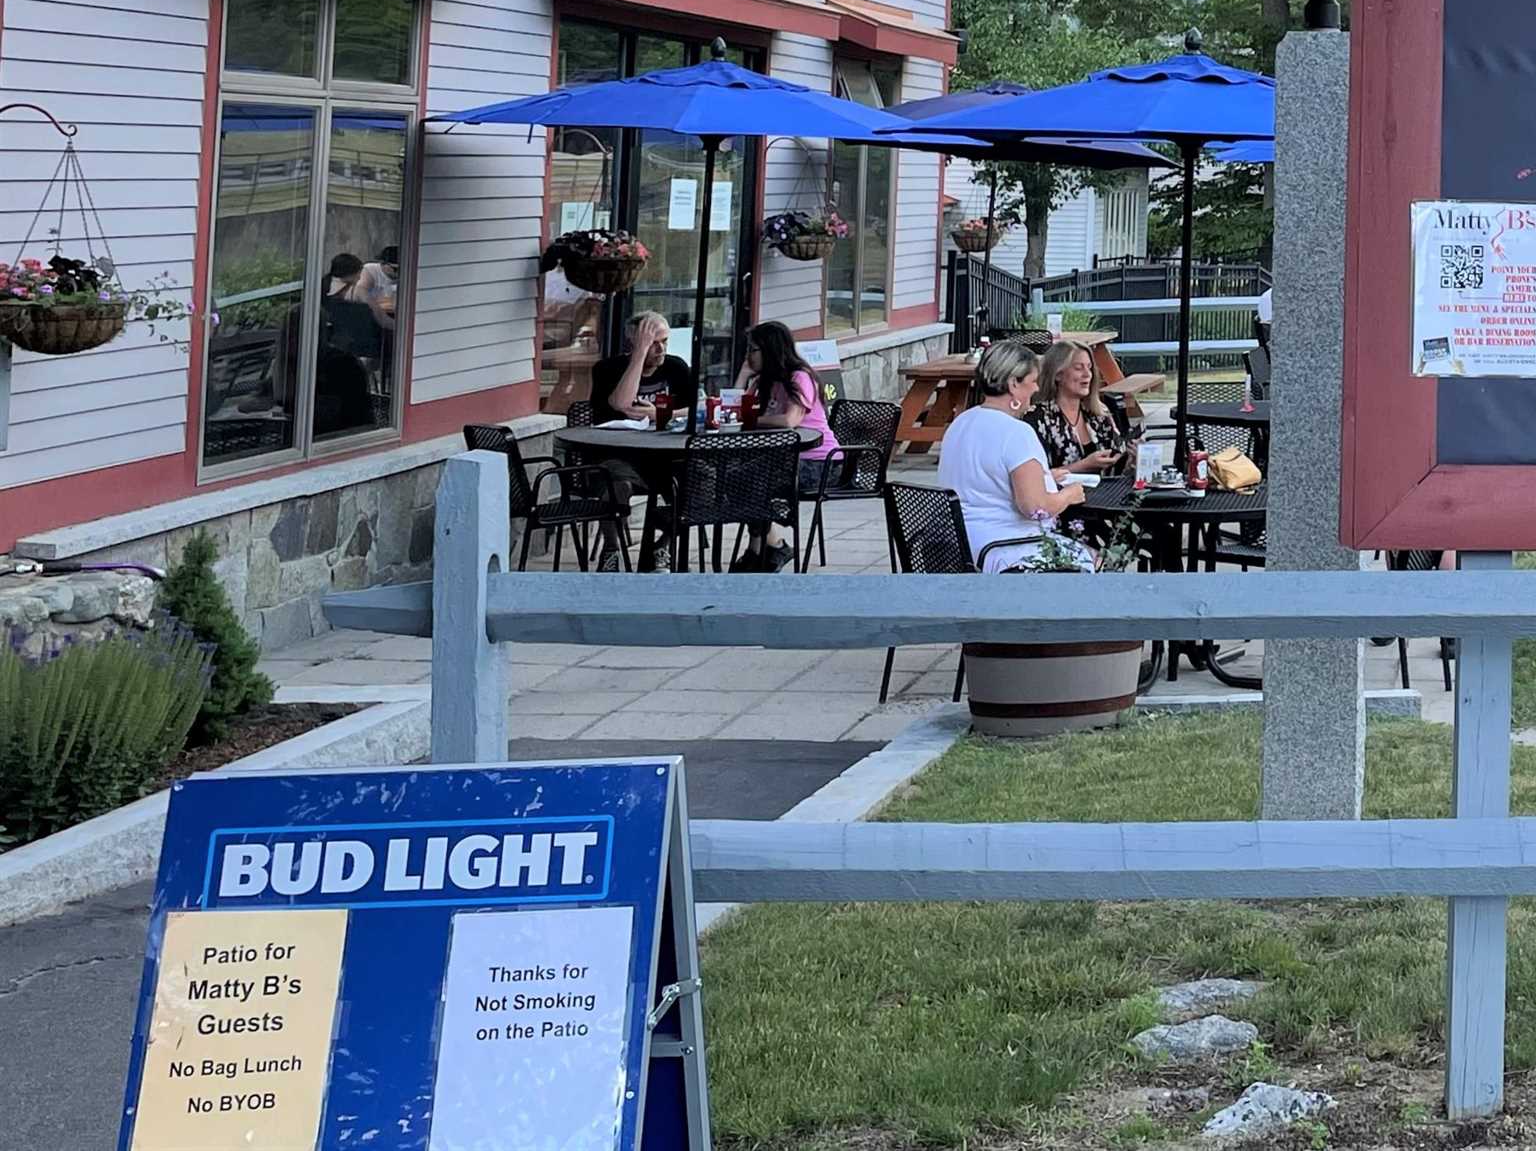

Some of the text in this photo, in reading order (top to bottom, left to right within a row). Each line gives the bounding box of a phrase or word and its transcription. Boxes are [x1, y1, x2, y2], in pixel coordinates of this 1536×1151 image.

[1434, 209, 1491, 236] Matty
[218, 831, 598, 897] BUD LIGHT
[203, 943, 296, 965] Patio for
[489, 963, 589, 983] Thanks for
[187, 974, 302, 1002] Matty B's
[475, 992, 596, 1012] Not Smoking
[197, 1012, 284, 1036] Guests
[476, 1020, 589, 1041] on the Patio
[168, 1055, 302, 1079] No Bag Lunch
[187, 1092, 276, 1113] No BYOB
